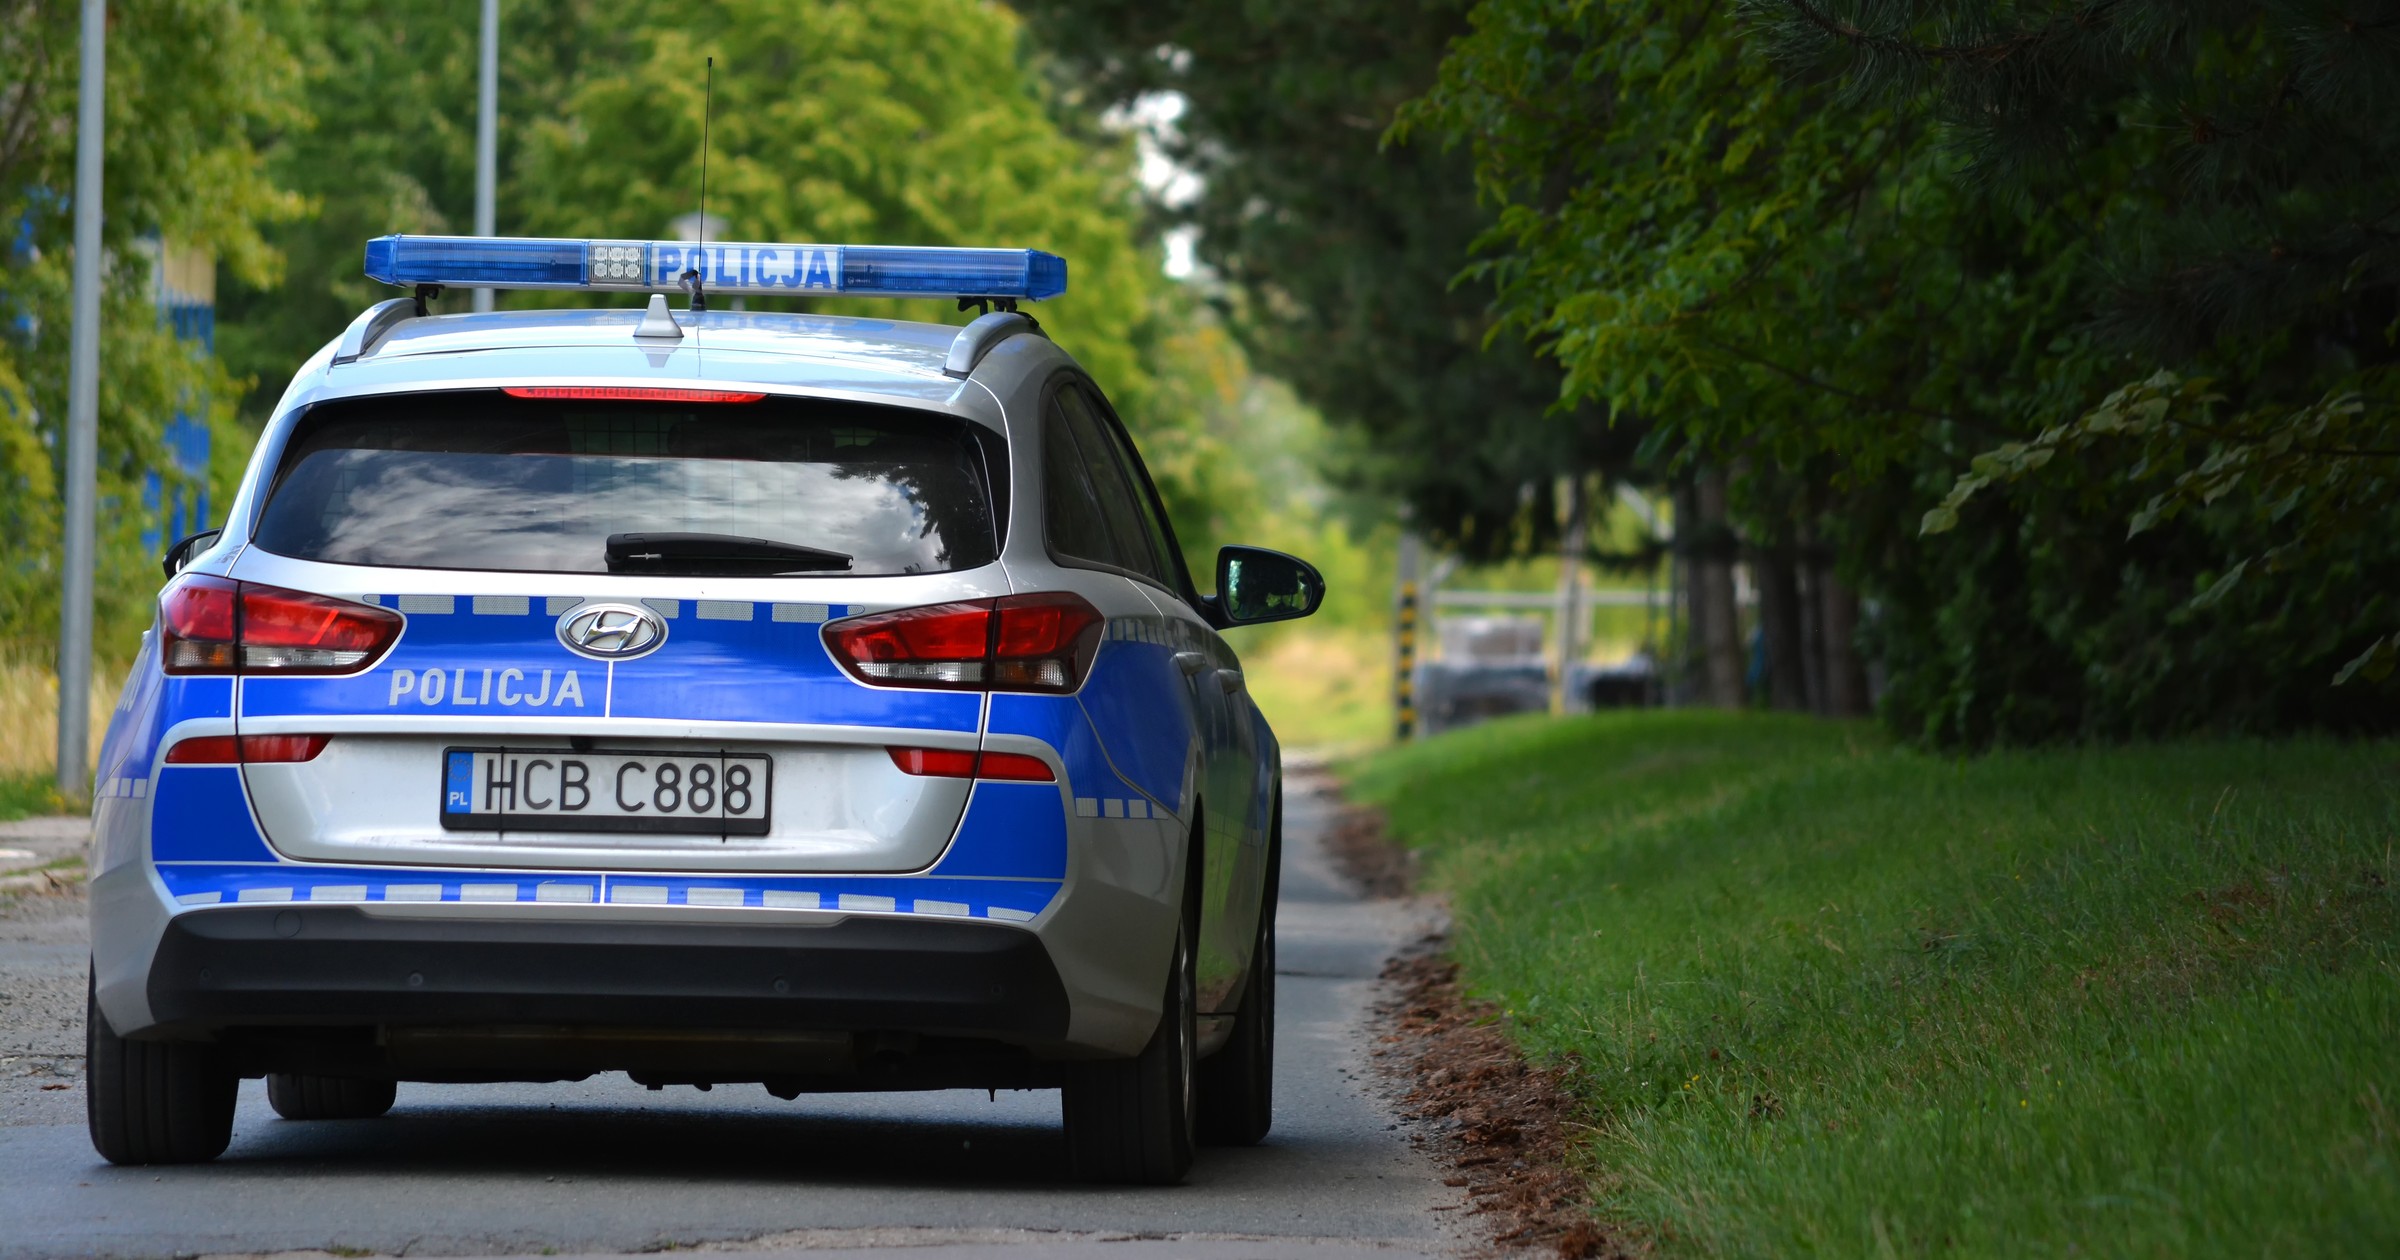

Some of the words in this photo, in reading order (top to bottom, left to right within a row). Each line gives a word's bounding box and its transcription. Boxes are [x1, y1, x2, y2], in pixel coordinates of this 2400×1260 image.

[658, 247, 832, 289] POLICJA
[389, 668, 584, 707] POLICJA
[450, 792, 468, 806] PL
[485, 759, 590, 811] HCB
[616, 762, 752, 814] C888
